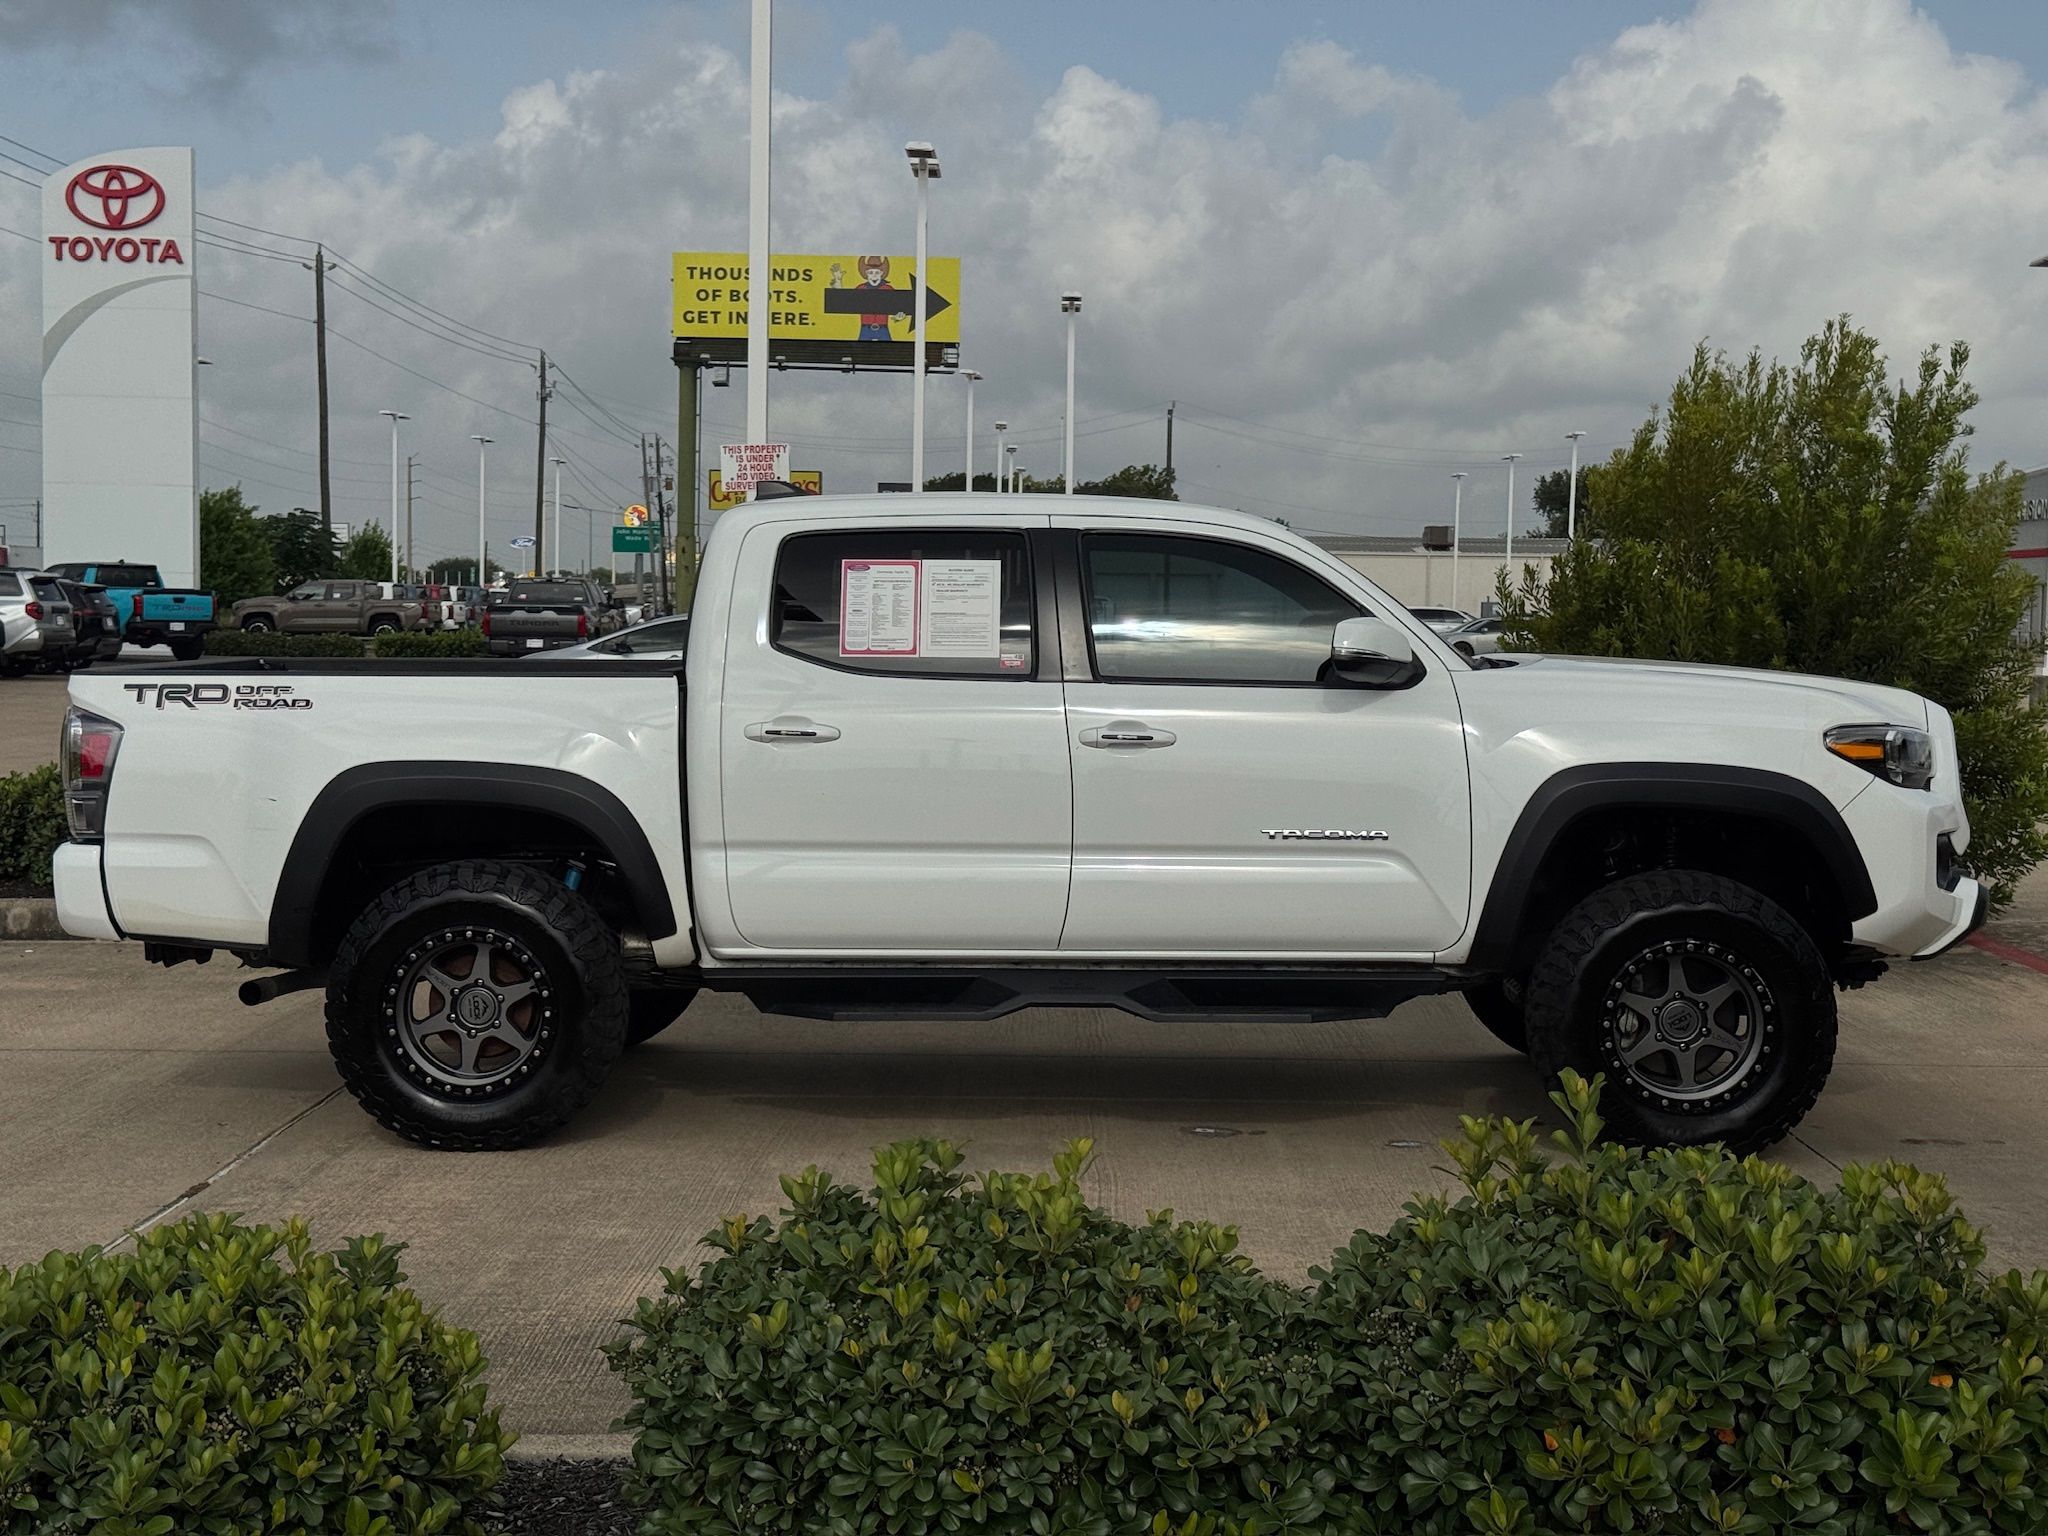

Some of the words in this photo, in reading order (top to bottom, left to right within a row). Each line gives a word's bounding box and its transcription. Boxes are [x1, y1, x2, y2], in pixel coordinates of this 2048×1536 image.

[48, 236, 184, 264] TOYOTA
[686, 266, 814, 282] THOUNDS
[695, 288, 722, 302] OF
[729, 289, 803, 303] BTS.
[682, 310, 722, 324] GET
[728, 311, 749, 325] IN
[771, 312, 816, 326] ERE.
[722, 446, 742, 455] THIS
[744, 444, 788, 454] PROPERTY
[735, 454, 744, 463] IS
[746, 454, 775, 463] UNDER
[737, 463, 748, 472] 24
[749, 463, 774, 472] HOUR
[736, 472, 748, 481] HD
[750, 472, 776, 481] VIDEO
[725, 481, 756, 491] SURVEI
[124, 683, 231, 710] TRD
[236, 685, 295, 698] OFF
[233, 698, 314, 710] ROAD
[1260, 828, 1390, 841] TACOMA
